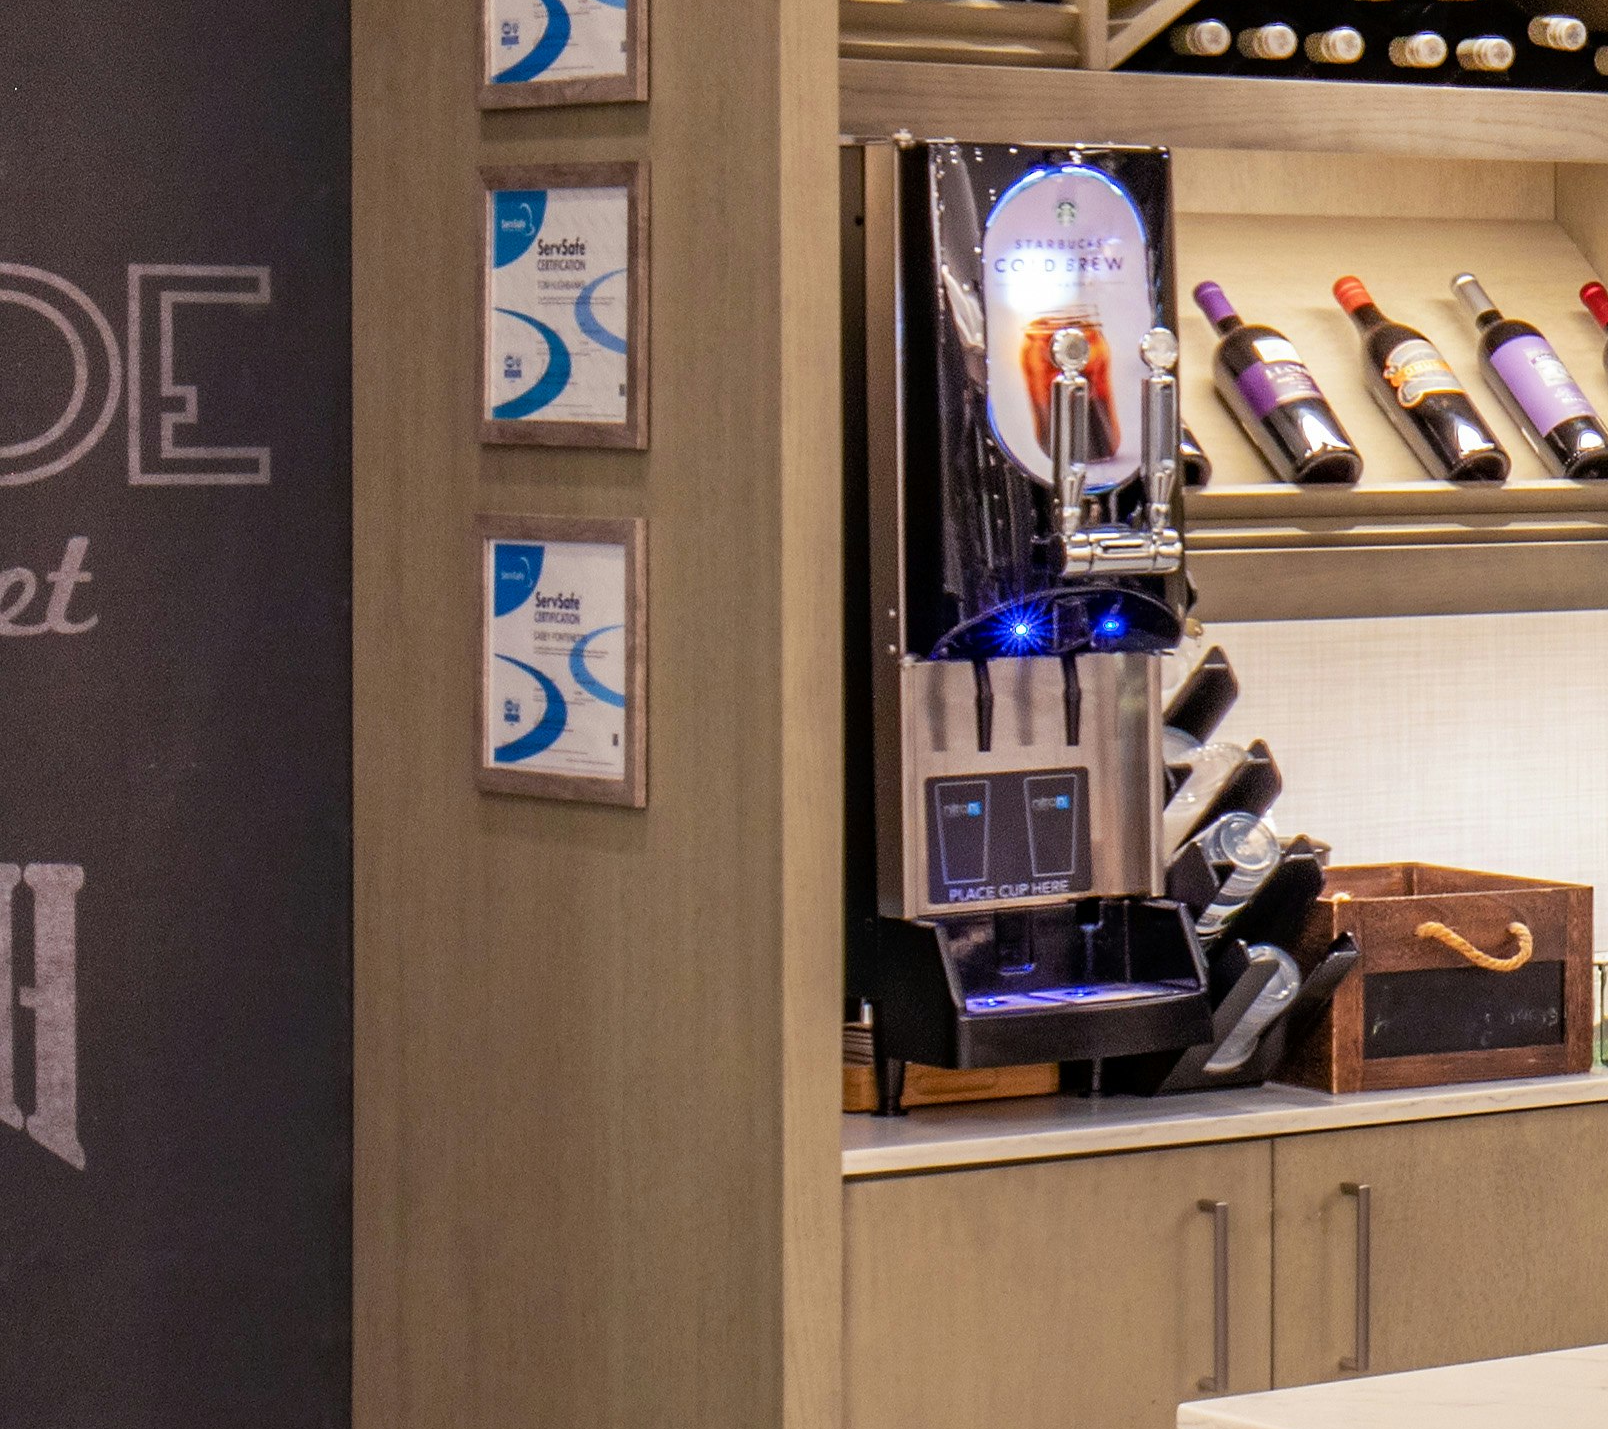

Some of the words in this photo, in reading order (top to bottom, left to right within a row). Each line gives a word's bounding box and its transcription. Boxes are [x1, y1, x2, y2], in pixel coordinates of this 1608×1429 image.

[537, 238, 587, 256] ServSafe
[537, 258, 587, 272] CERTIFICATION
[535, 591, 582, 611] ServSafe
[534, 611, 582, 625] CERTIFICATION
